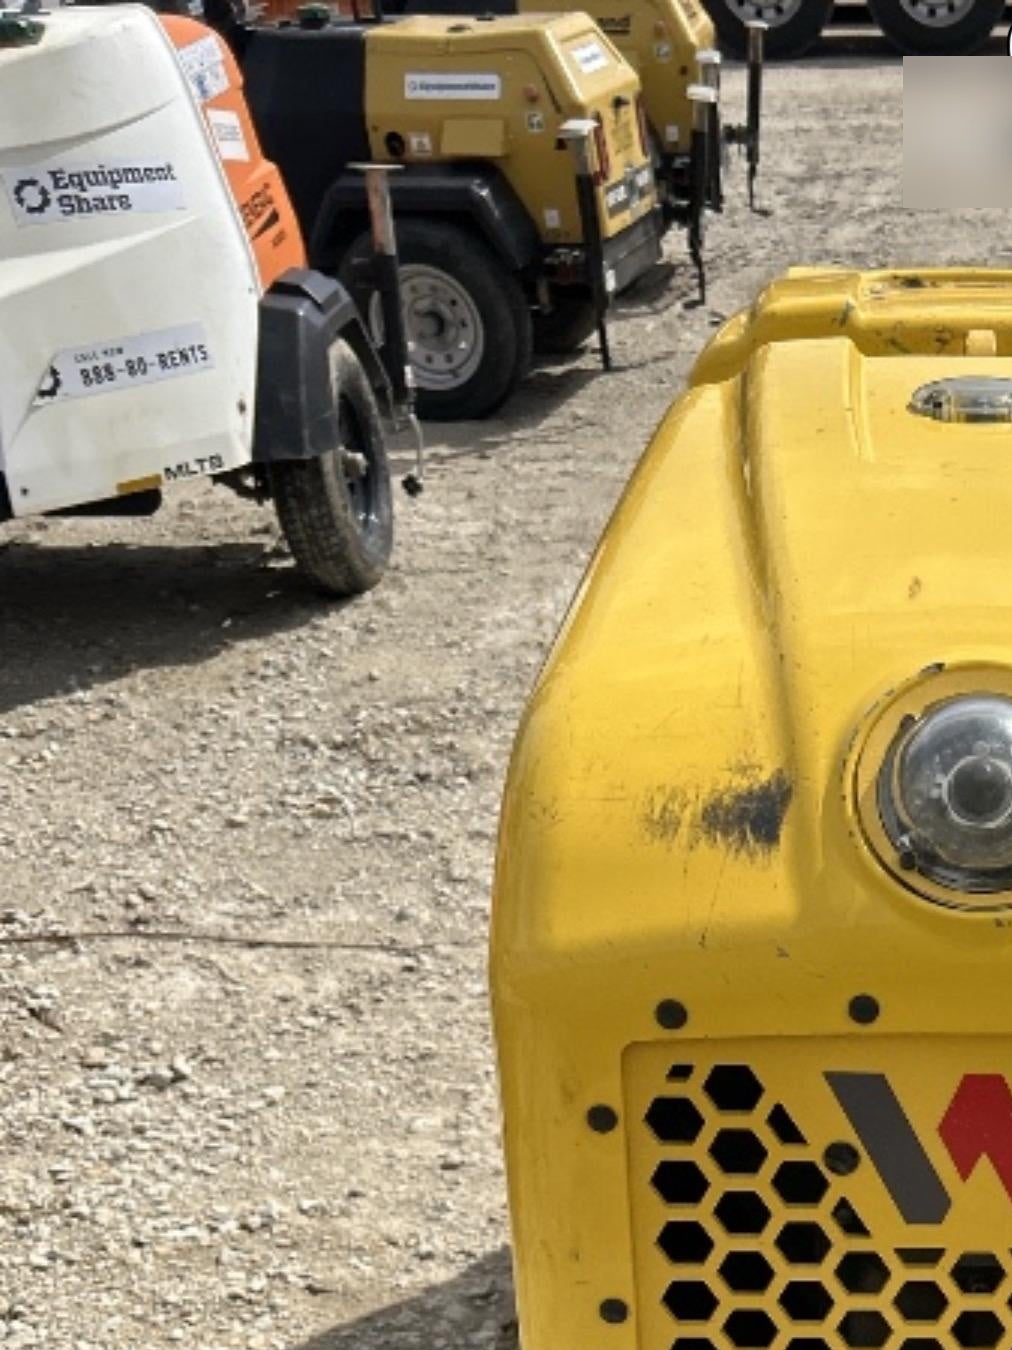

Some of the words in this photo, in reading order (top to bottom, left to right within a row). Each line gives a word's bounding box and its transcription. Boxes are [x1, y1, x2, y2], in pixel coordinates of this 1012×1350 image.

[48, 162, 177, 192] Equipment
[56, 192, 133, 217] Share
[79, 344, 209, 388] 888-80-RENTS
